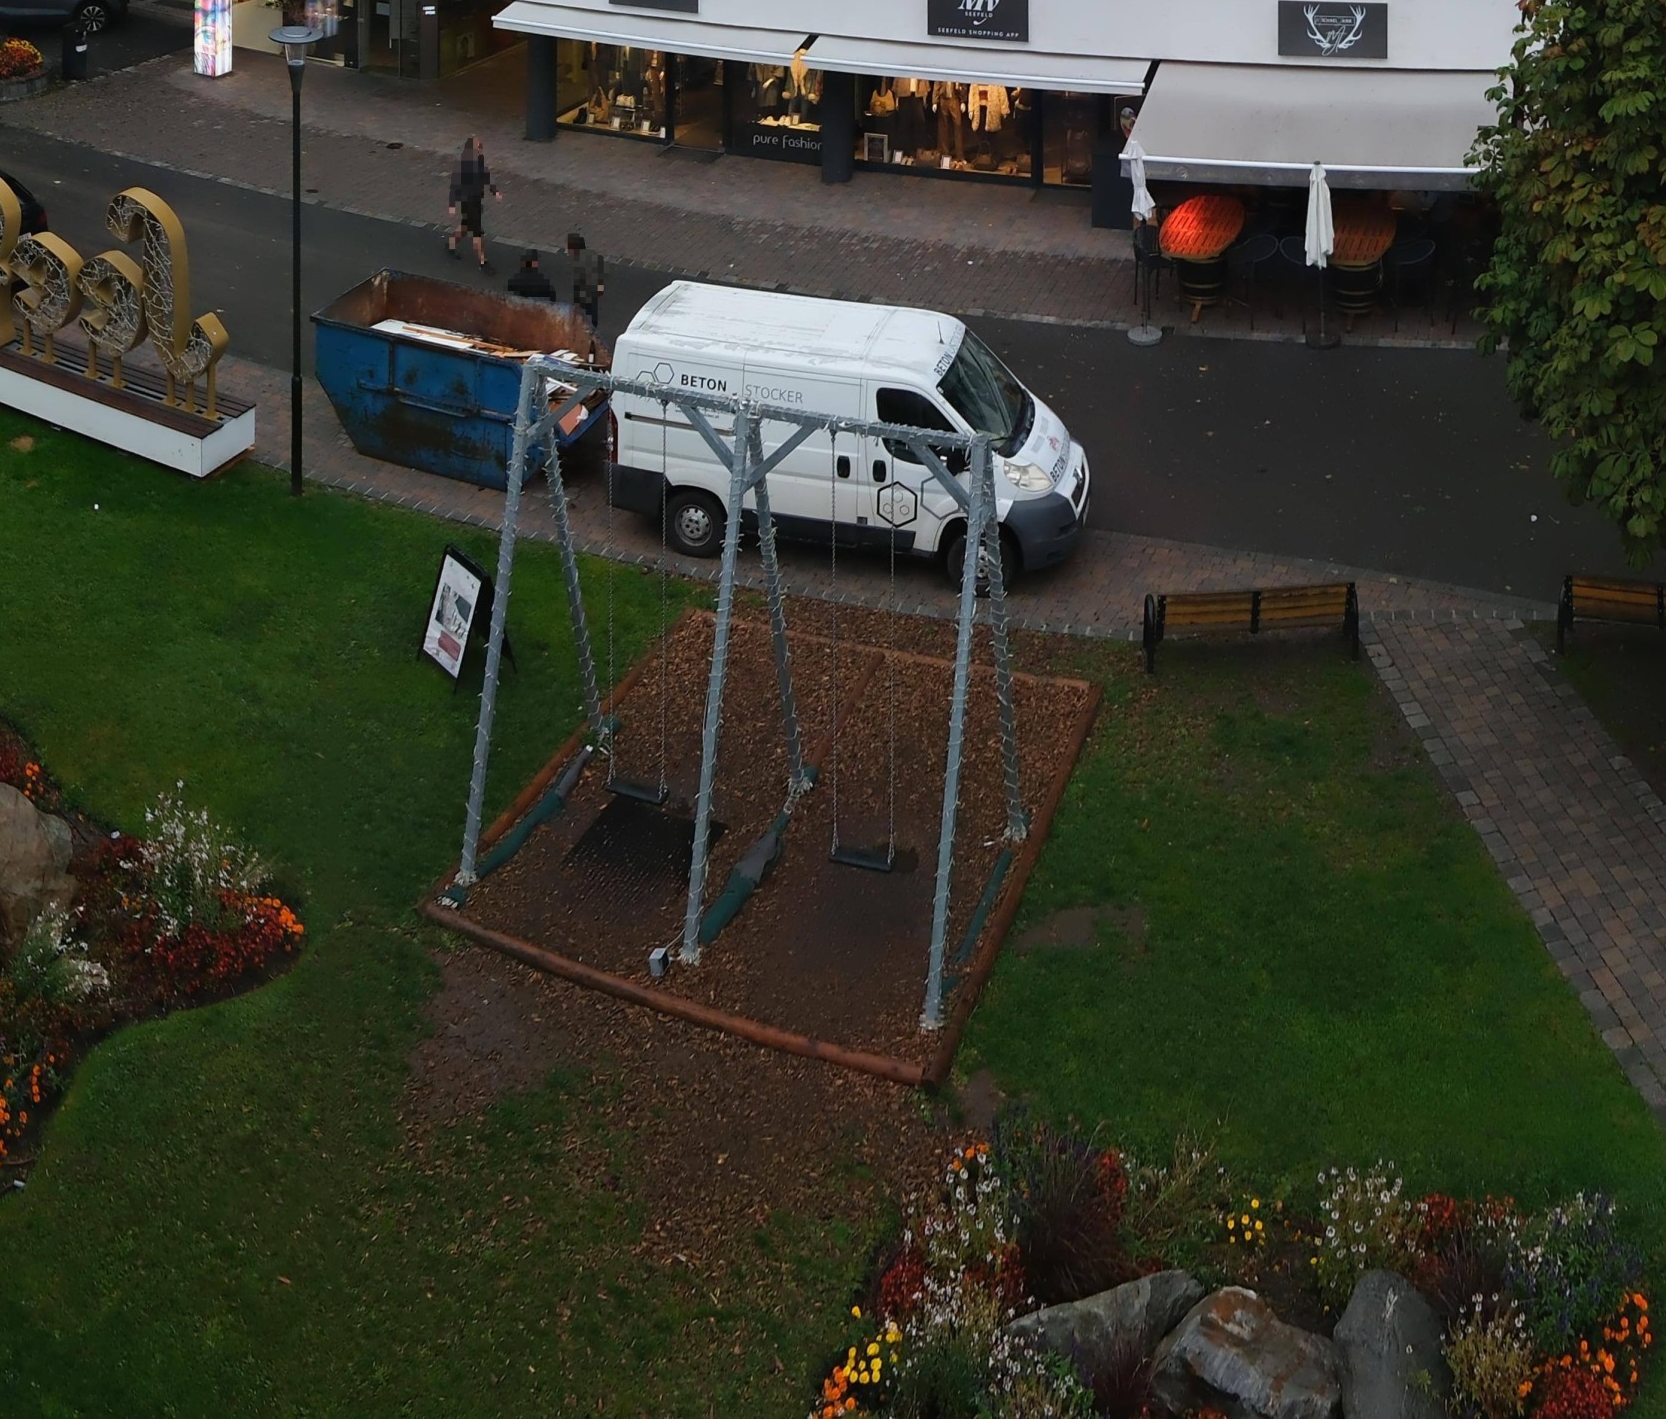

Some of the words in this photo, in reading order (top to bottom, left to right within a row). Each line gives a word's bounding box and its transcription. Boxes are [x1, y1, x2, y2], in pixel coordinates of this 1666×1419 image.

[938, 27, 967, 35] SEEFELD
[969, 29, 1004, 37] SHOPPING
[753, 134, 779, 145] pure
[934, 349, 954, 377] BETON
[680, 374, 727, 392] BETON
[745, 384, 803, 404] STOCKER
[1050, 456, 1066, 482] BETON
